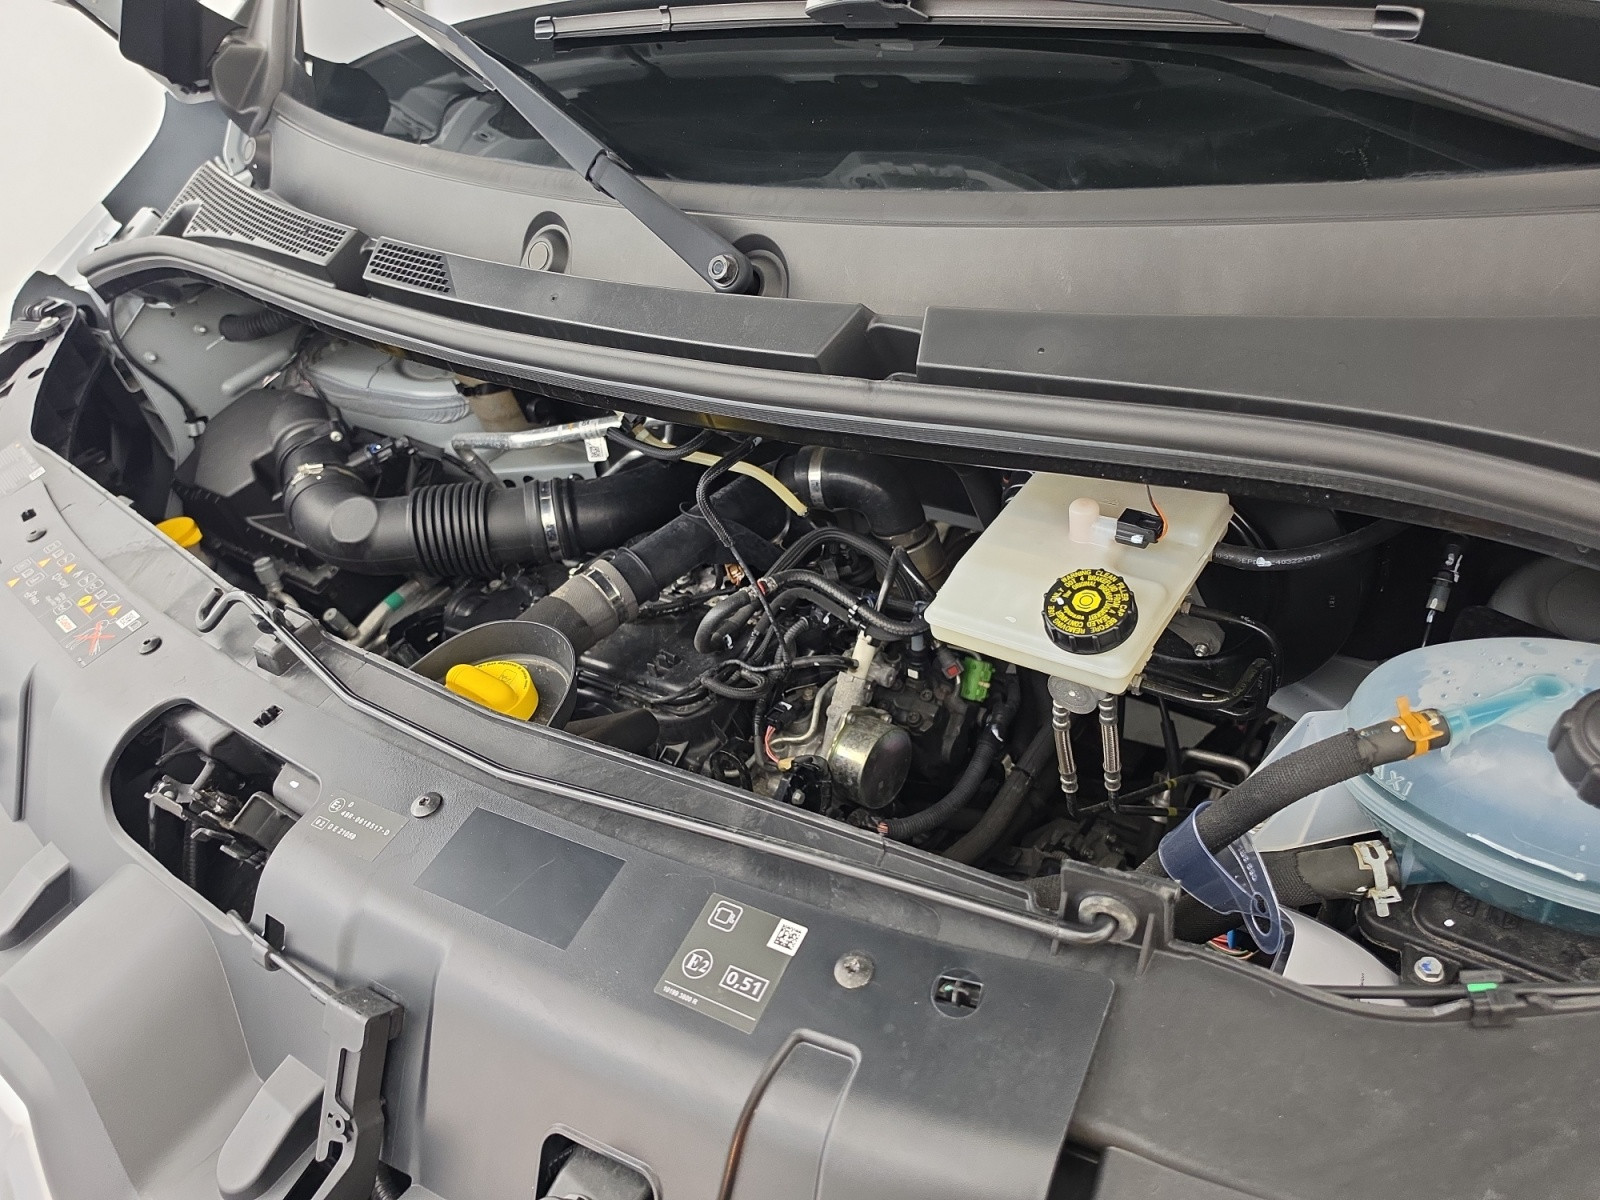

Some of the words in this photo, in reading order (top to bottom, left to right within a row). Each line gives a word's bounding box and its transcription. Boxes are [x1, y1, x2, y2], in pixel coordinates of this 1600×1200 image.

[1061, 570, 1092, 582] WARNING
[1064, 579, 1077, 588] DOT
[1095, 570, 1118, 582] CLEAN
[1116, 582, 1130, 601] FILLER
[1113, 593, 1121, 608] FROM
[1047, 605, 1056, 617] USE
[1117, 604, 1128, 617] CAP
[1052, 618, 1086, 634] REMOVING
[1055, 609, 1084, 628] CONTAINER
[1086, 614, 1111, 628] SEALED
[1090, 617, 1118, 633] BEFORE
[685, 953, 710, 973] E2
[725, 971, 763, 996] 0,51
